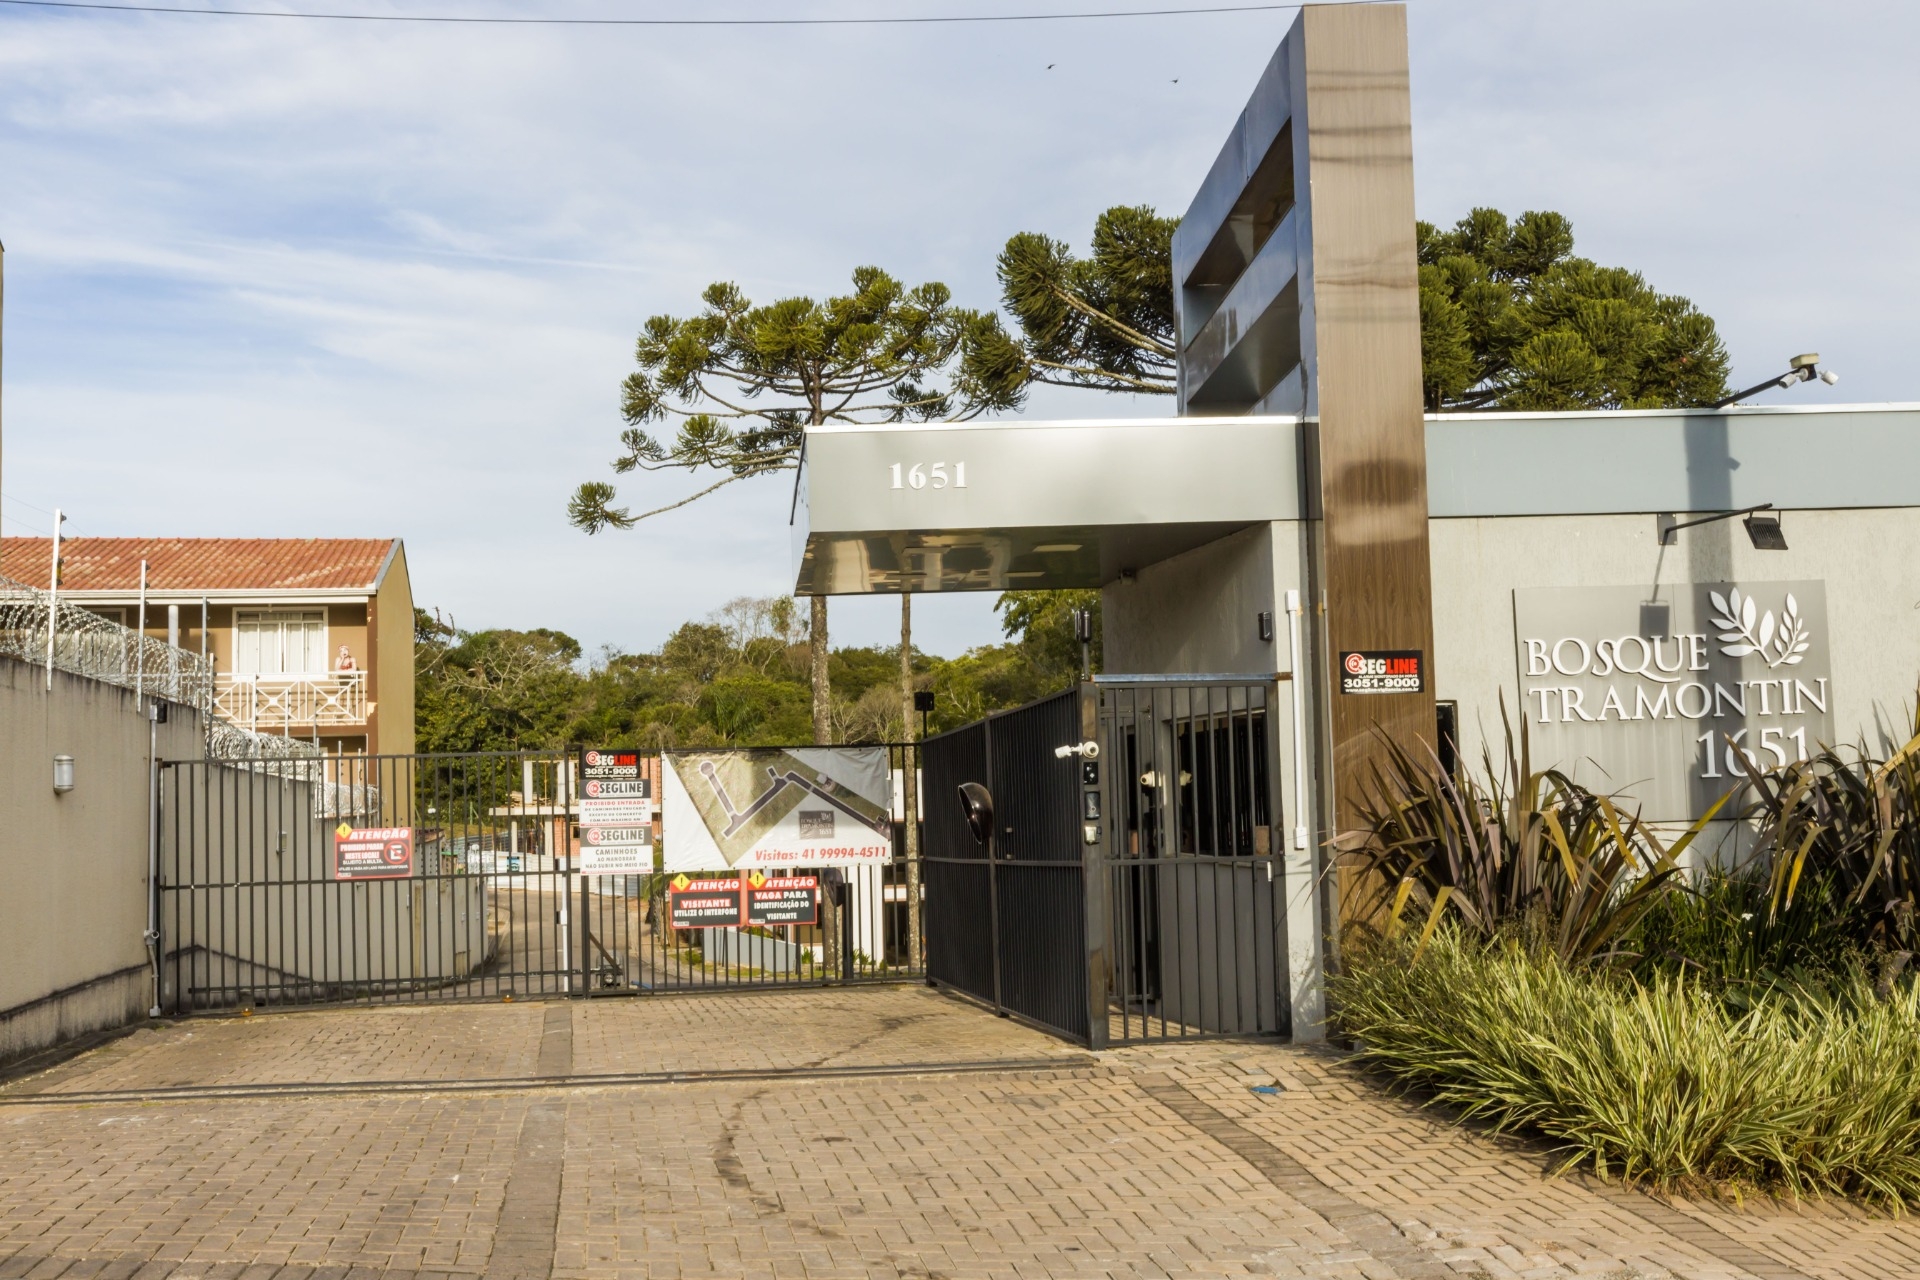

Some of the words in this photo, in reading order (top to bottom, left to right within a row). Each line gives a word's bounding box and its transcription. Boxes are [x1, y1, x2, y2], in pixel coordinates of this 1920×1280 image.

[888, 461, 967, 490] 1651
[1524, 634, 1710, 683] BOSQUE
[1358, 658, 1418, 674] SEGLINE
[1344, 678, 1420, 688] 3051-9000
[1527, 678, 1828, 724] TRAMONTIN
[1696, 726, 1810, 779] 1651
[599, 782, 642, 794] SEGLINE
[349, 828, 409, 840] ATENÇÃO
[600, 830, 643, 841] SEGLINE
[755, 849, 798, 860] Visitas:
[802, 849, 815, 859] 41
[820, 847, 886, 859] 99994-4511
[689, 879, 739, 891] ATENÇÃO
[765, 877, 814, 889] ATENÇÃO
[681, 899, 731, 908] VISITANTE
[754, 900, 799, 909] IDENTIFICAÇÃO
[674, 909, 697, 917] UTILIZE
[704, 908, 738, 916] INTERFONE
[766, 912, 797, 920] VISITANTE
